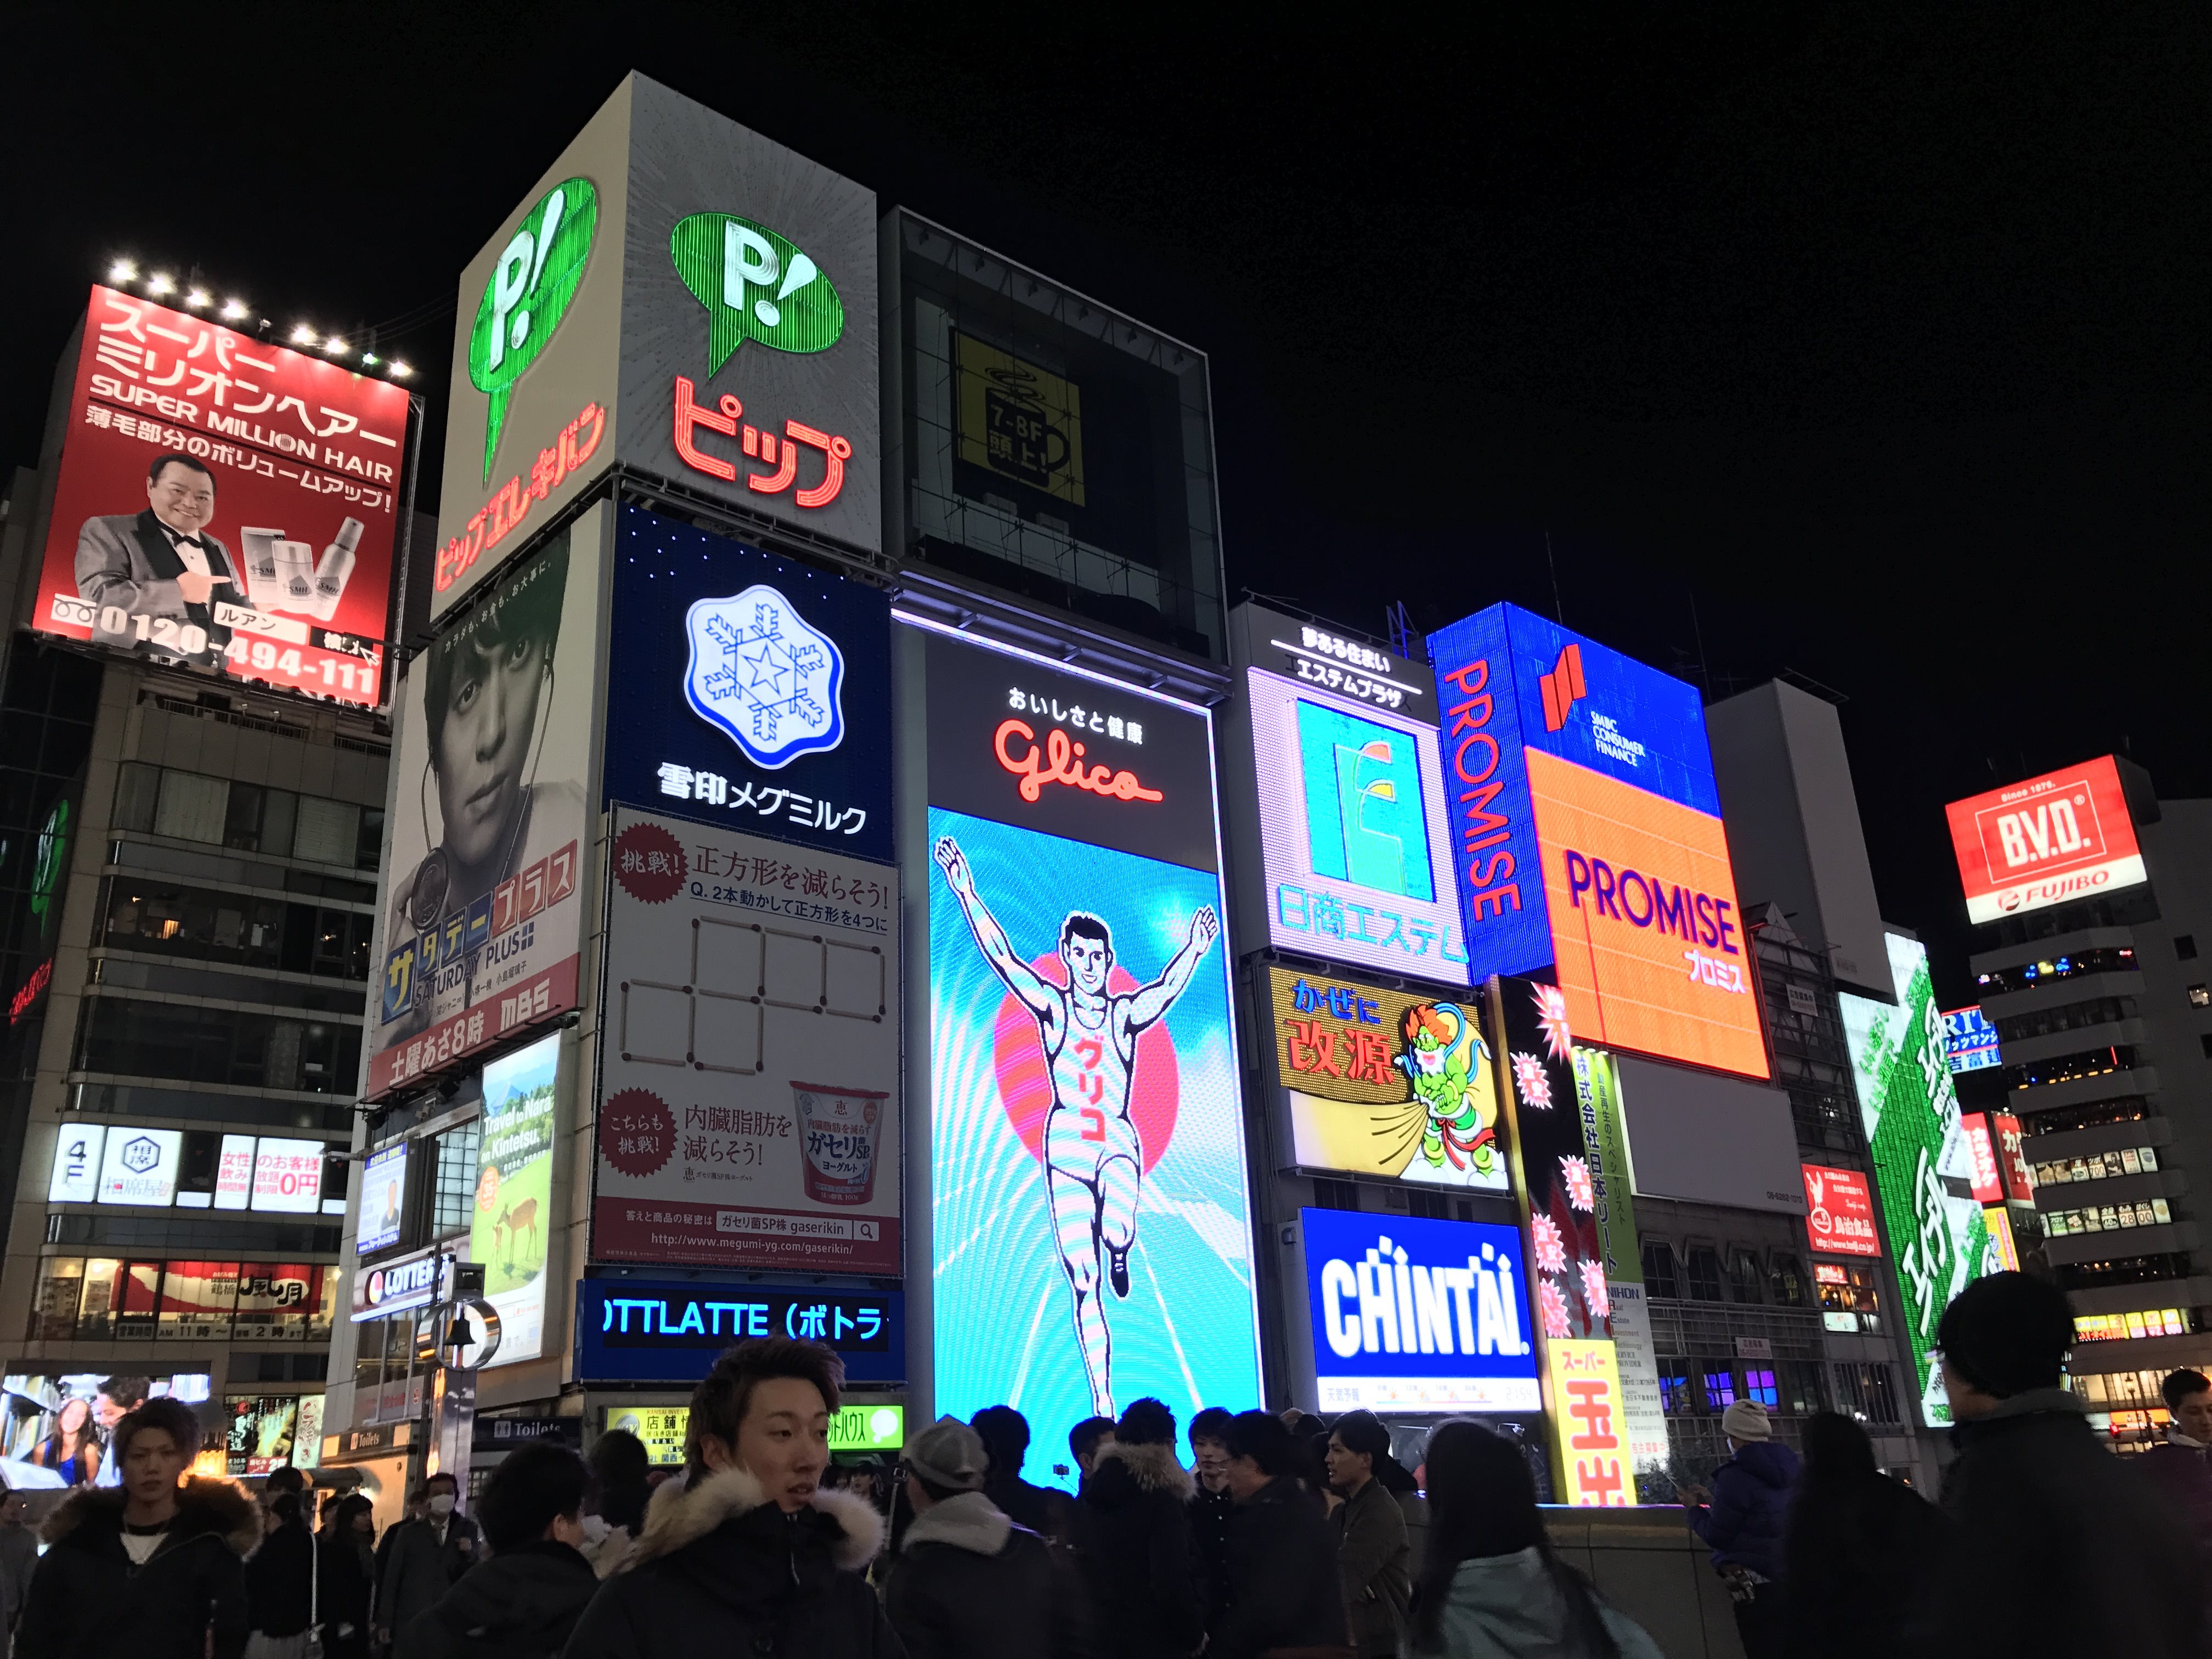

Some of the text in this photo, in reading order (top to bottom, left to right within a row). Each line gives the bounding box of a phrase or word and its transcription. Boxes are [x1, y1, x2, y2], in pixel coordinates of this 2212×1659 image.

[100, 299, 276, 374] スーパー
[96, 334, 397, 448] ミリオンヘアー
[89, 375, 393, 483] SUPER MILLION HAIR
[675, 376, 851, 508] ピップ
[85, 406, 391, 514] 薄毛部分のボリュームアップ!
[435, 402, 604, 592] ピップエレキバン
[221, 609, 276, 631] ルアン
[100, 605, 375, 694] 0120-494-111
[1296, 658, 1403, 709] エステムプラザ
[1008, 687, 1143, 745] おいしさと健康
[1591, 711, 1618, 734] SMBC
[1593, 724, 1646, 758] CONSUMER
[1595, 739, 1638, 768] FINANCE
[657, 762, 866, 834] 雪印メグミルク
[1443, 658, 1522, 922] PROMISE
[1997, 798, 2092, 868] B.V.D.
[620, 848, 680, 875] 挑戦!
[692, 844, 889, 910] 正方形を減らそう!
[1567, 849, 1740, 956] PROMISE
[2025, 869, 2109, 903] FUJIBO
[1279, 884, 1469, 964] 日商エステム
[415, 932, 520, 1007] SATURDAY PLUS
[1684, 949, 1746, 995] プロミス
[1293, 979, 1381, 1024] かぜに
[389, 1011, 484, 1086] 土曜あさ8時
[1286, 1020, 1395, 1085] 改源
[834, 1099, 848, 1115] 恵
[1074, 1035, 1107, 1142] グリコ
[484, 1096, 552, 1136] Travel to Nara
[610, 1115, 664, 1132] こちらも
[684, 1104, 792, 1138] 内臓脂肪を
[221, 1151, 320, 1172] 女性のお客様
[481, 1151, 490, 1164] on
[492, 1127, 540, 1160] Kintetsu.
[618, 1136, 660, 1155] 挑戦!
[683, 1135, 763, 1166] 減らそう!
[808, 1131, 857, 1159] ガセリ
[1576, 1054, 1618, 1276] 株式会社日本リート
[219, 1167, 280, 1184] 飲み放題
[279, 1172, 319, 1197] 0円
[822, 1160, 857, 1173] ヨーグルト
[217, 1182, 278, 1195] 時間無制限
[626, 1209, 844, 1235] 答えと商品の秘密は ガセリ菌SP株 gaserikin
[652, 1232, 854, 1255] http://www.megumi-yg.com/gaserikin/
[385, 1253, 449, 1296] LOTTER
[1607, 1286, 1640, 1300] NIHON
[1321, 1243, 1522, 1357] CHINTAI
[1562, 1350, 1606, 1372] スーパー
[1327, 1387, 1360, 1402] 天気予報
[359, 1432, 380, 1447] Toilets
